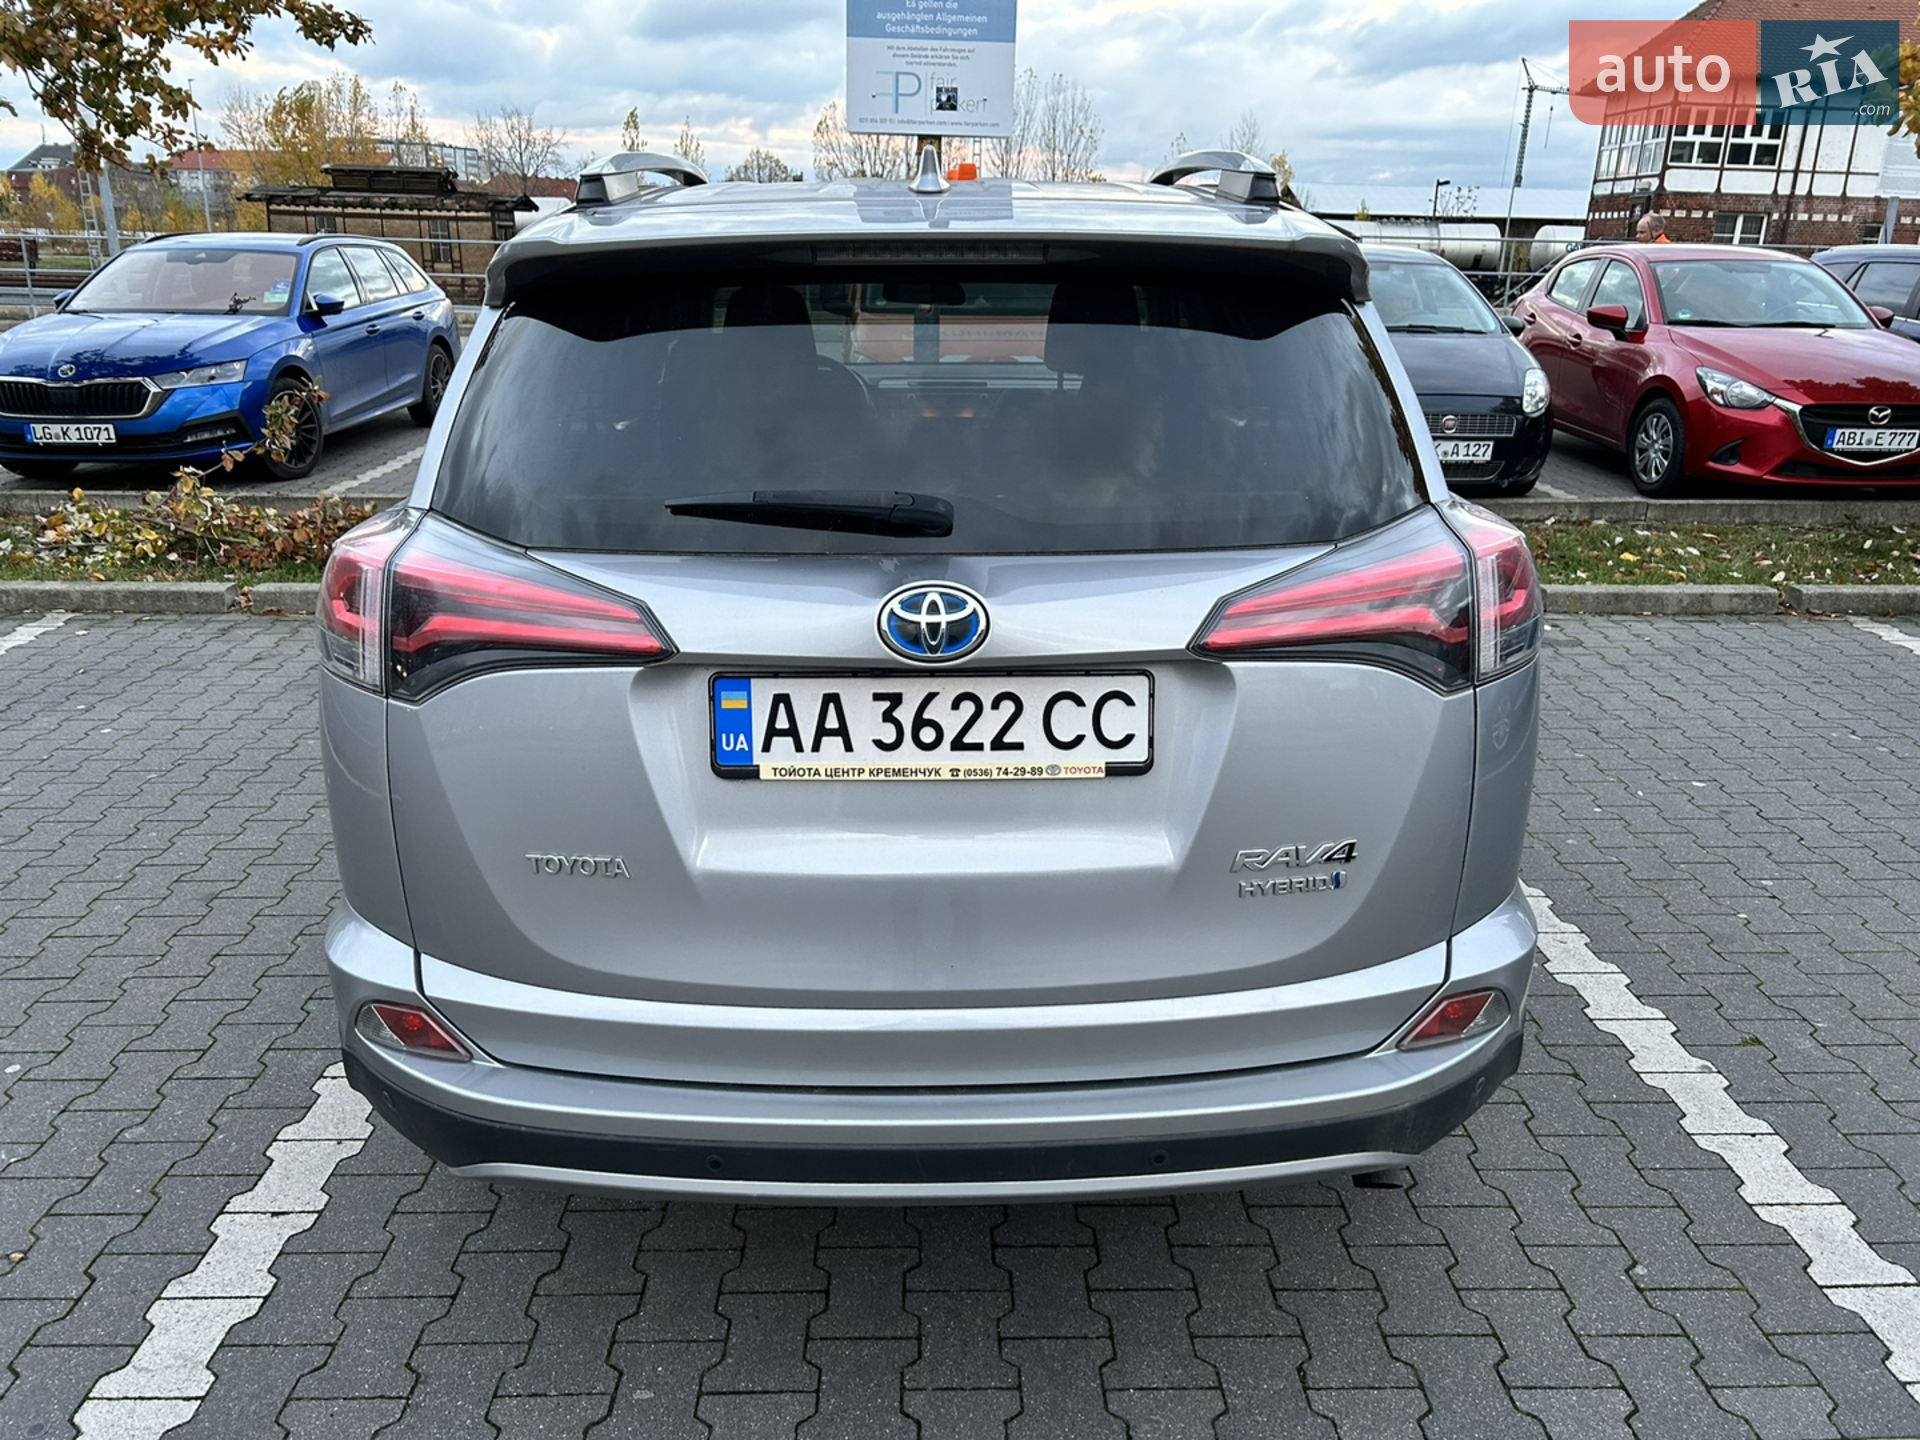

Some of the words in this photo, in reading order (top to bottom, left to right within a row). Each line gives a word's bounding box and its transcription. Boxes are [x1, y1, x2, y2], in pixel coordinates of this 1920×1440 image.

[876, 11, 934, 22] ausgehängten
[936, 12, 988, 24] Allgemeinen
[885, 23, 978, 37] Geschäftsbedingungen
[929, 71, 957, 90] fair
[32, 426, 53, 441] LG
[60, 426, 73, 441] K
[74, 426, 115, 441] 1071
[1835, 431, 1866, 446] ABI
[1874, 431, 1886, 446] E
[1887, 431, 1917, 446] 777
[1450, 443, 1460, 457] A
[1462, 443, 1491, 457] 127
[761, 692, 854, 753] AA
[871, 691, 1025, 752] 3622
[1042, 690, 1136, 750] CC
[722, 734, 749, 751] UA
[772, 766, 821, 778] ТОЙОТА
[825, 767, 866, 779] ЦЕНТР
[868, 766, 942, 778] КРЕМЕНЧУК
[963, 767, 993, 778] (0536)
[995, 766, 1044, 777] 74-29-89
[1063, 765, 1105, 776] TOYOTA
[1229, 838, 1358, 873] RAV4
[525, 853, 631, 879] TOYOTA
[1239, 875, 1329, 898] HYBRID
